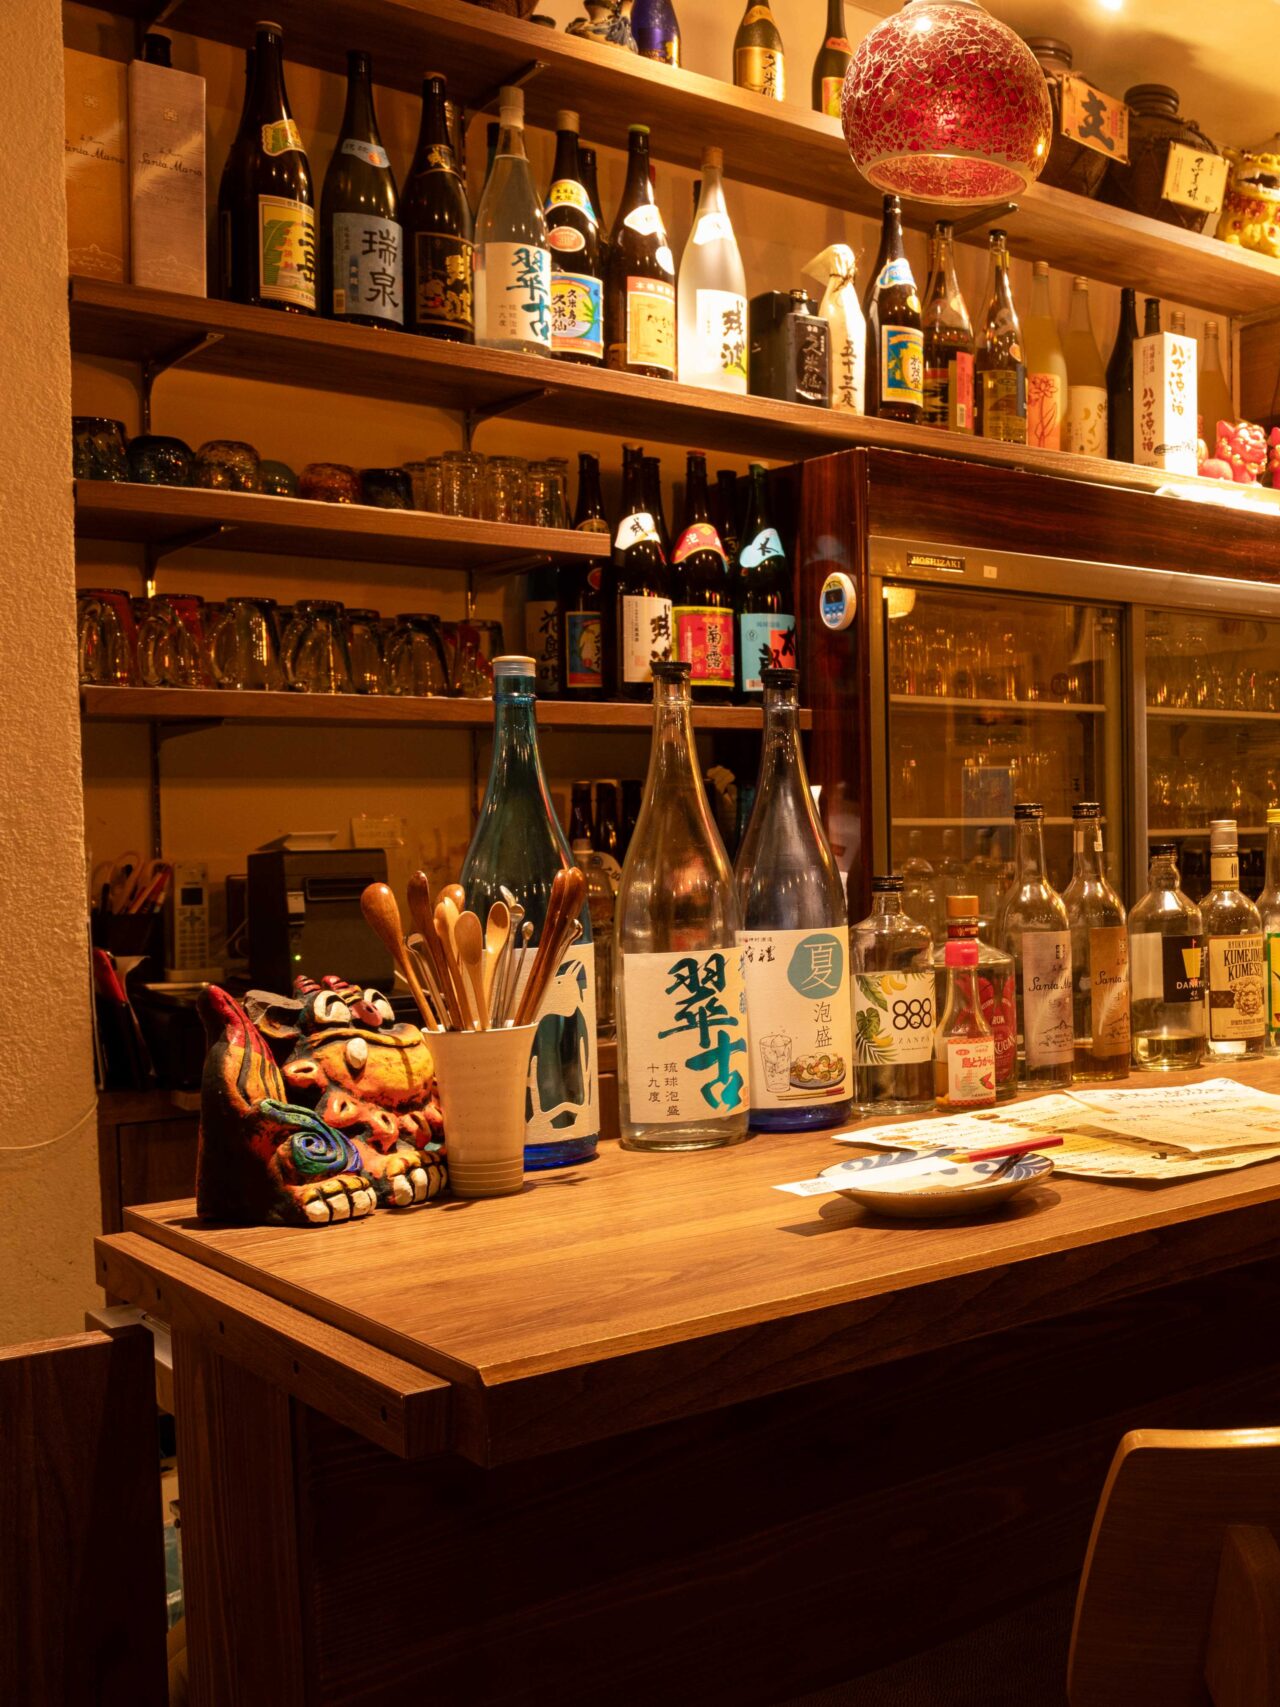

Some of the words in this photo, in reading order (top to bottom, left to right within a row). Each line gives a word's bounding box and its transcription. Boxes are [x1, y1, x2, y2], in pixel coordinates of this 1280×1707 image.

[139, 152, 167, 169] Santa
[362, 228, 399, 308] 瑞泉
[552, 294, 567, 331] 久米仙
[567, 289, 577, 327] 久米島の
[911, 556, 961, 569] HOSHIZAKI
[706, 624, 722, 669] 菊之露
[801, 941, 838, 991] 夏
[1028, 976, 1059, 992] Santa
[1095, 970, 1122, 986] Santa
[658, 952, 748, 1112] 翠古
[813, 1001, 833, 1049] 泡盛
[647, 1065, 661, 1103] 十九度
[663, 1062, 681, 1117] 琉球泡盛
